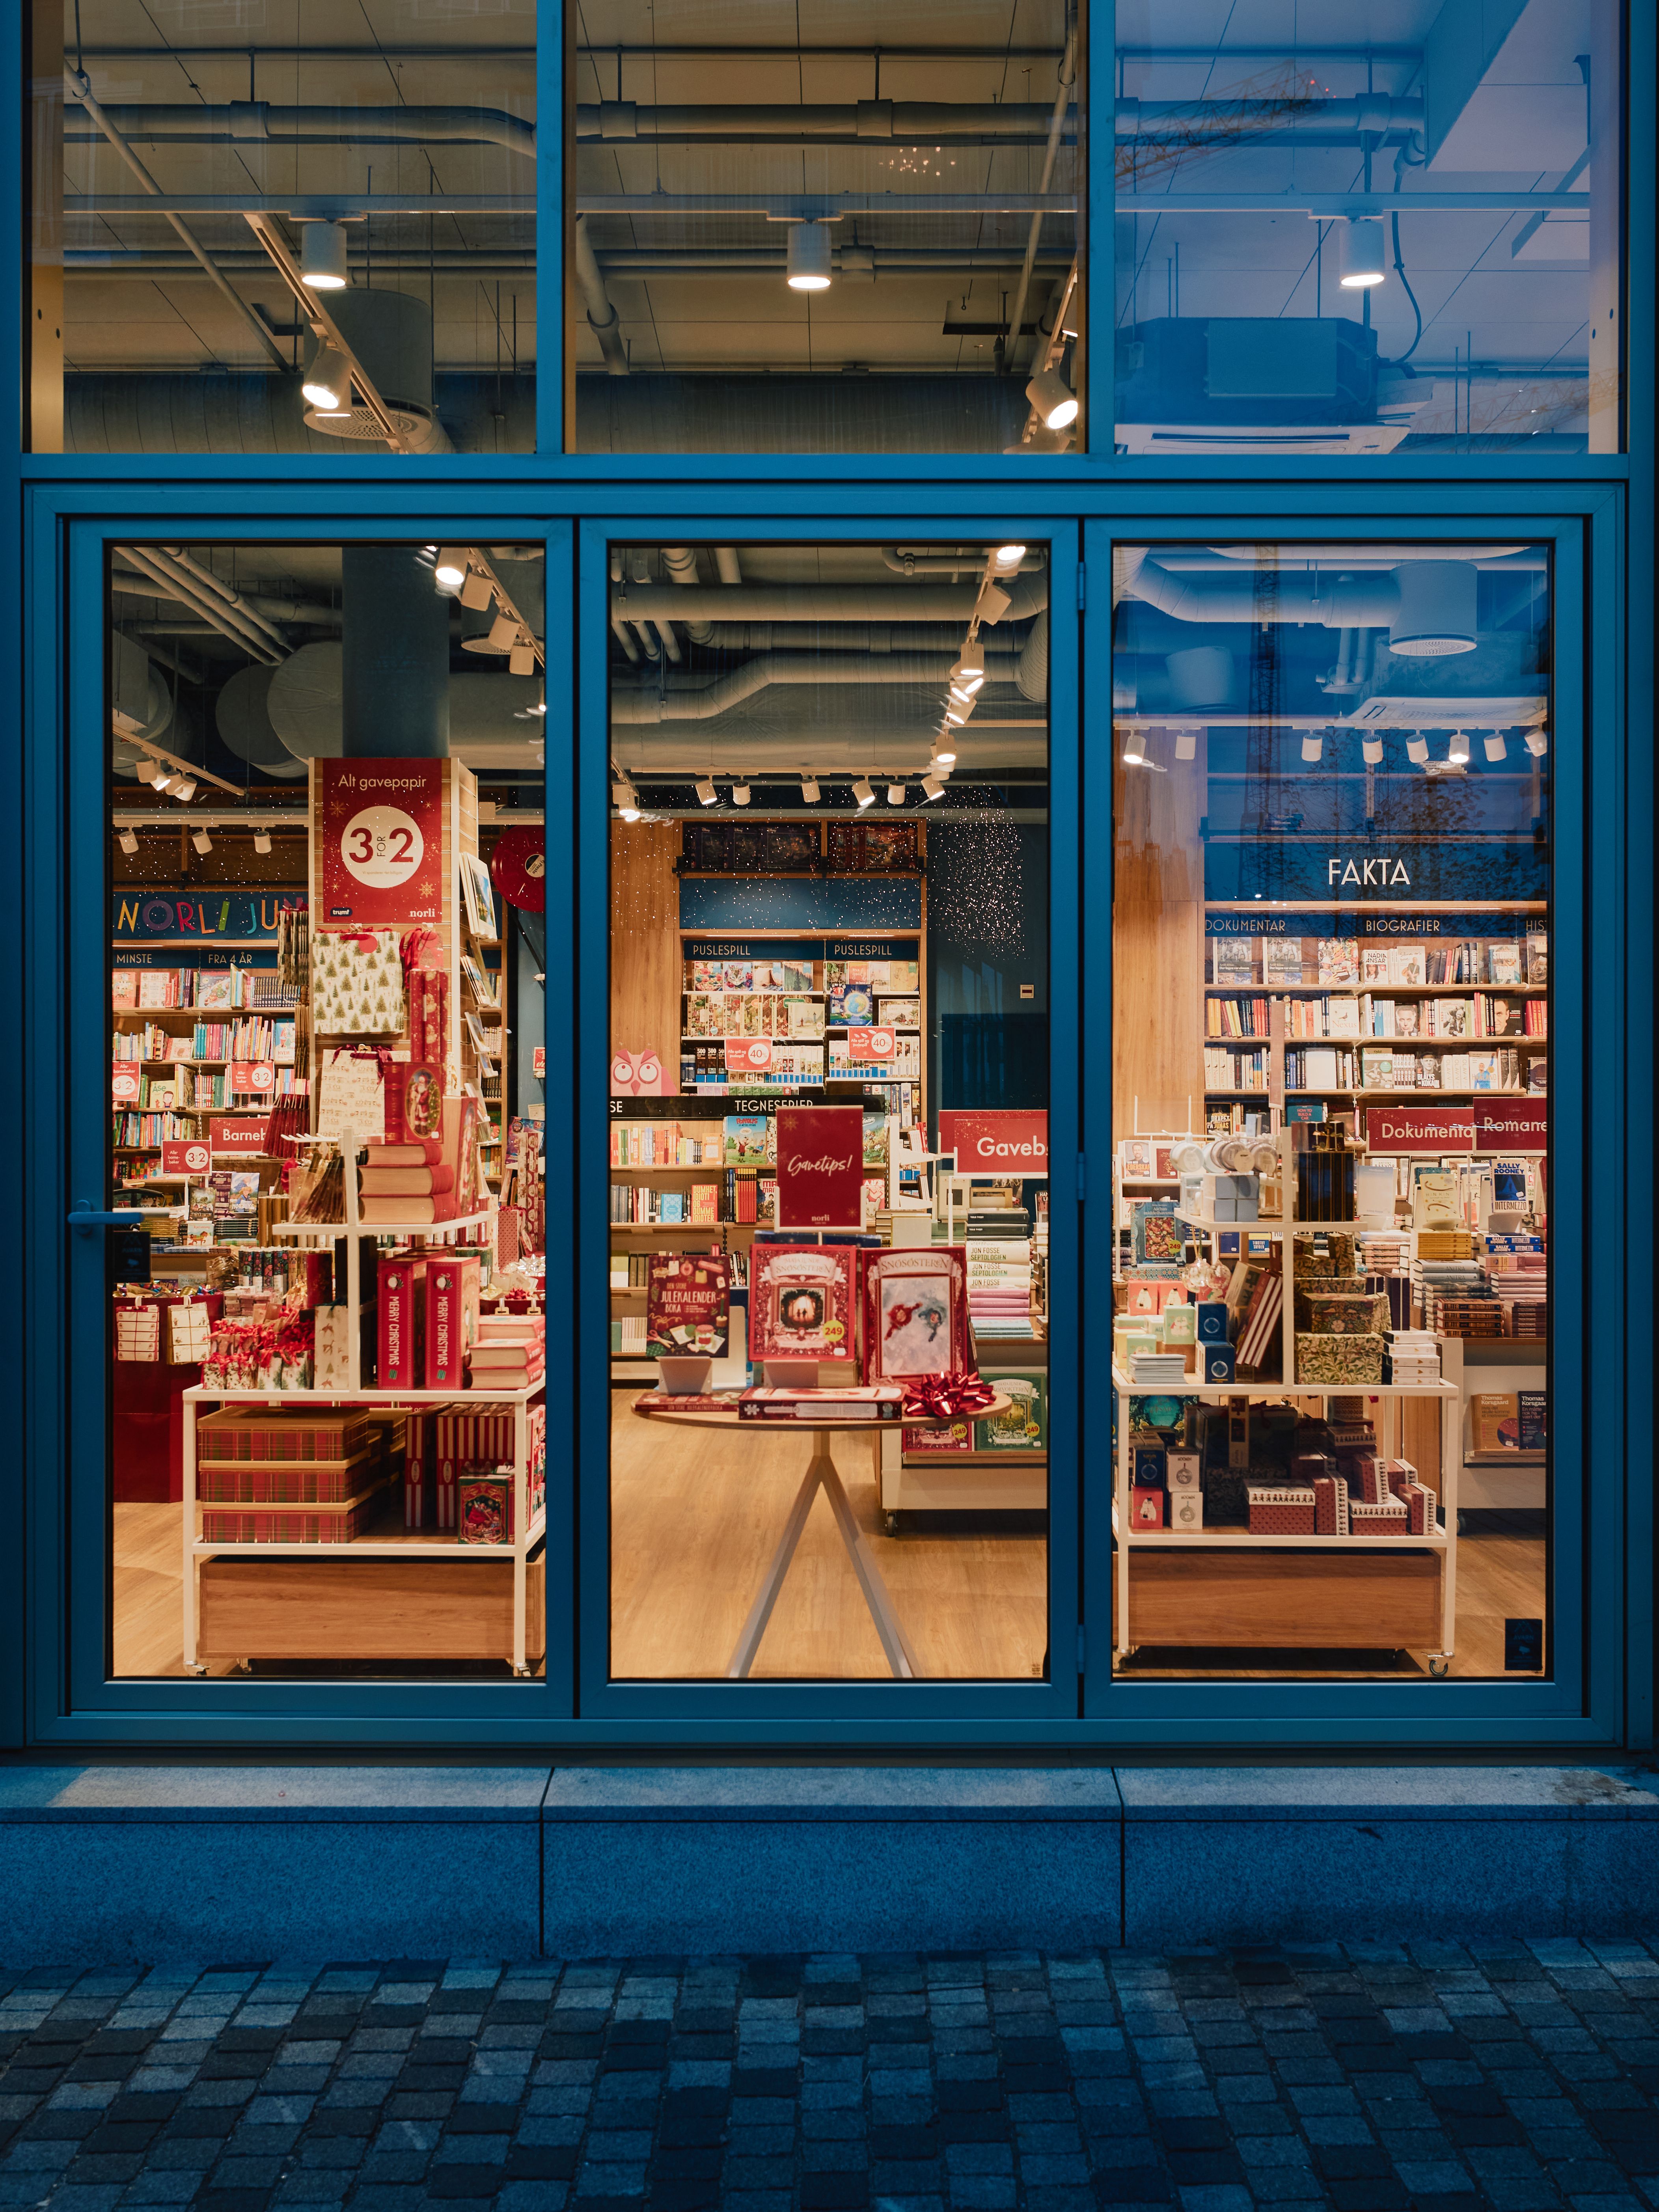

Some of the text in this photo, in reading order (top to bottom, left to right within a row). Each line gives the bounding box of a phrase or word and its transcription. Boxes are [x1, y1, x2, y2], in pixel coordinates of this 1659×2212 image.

[339, 774, 427, 790] Alt gavepapir
[349, 827, 414, 863] 3 FOR 2
[1329, 859, 1411, 885] FAKTA
[117, 899, 230, 935] NORLI
[410, 908, 436, 917] norli
[1205, 919, 1286, 931] DOKUMENTAR
[1366, 920, 1440, 931] BIOGRAFIER
[1526, 920, 1547, 931] HIS
[693, 945, 751, 956] PUSLESPILL
[835, 945, 892, 956] PUSLESPILL
[117, 954, 153, 963] MINSTE
[209, 952, 252, 964] FRA 4 ÅR
[254, 1073, 269, 1081] 3 2
[126, 1081, 132, 1089] 2
[152, 1081, 166, 1092] Åse
[1381, 1122, 1473, 1138] Dokumenta
[977, 1135, 1048, 1156] Gaveb
[188, 1152, 205, 1162] 3 2
[787, 1154, 853, 1177] Gavetips!
[693, 1185, 717, 1194] DUMHET,
[1495, 1201, 1527, 1211] INTERMEZZO
[660, 1290, 721, 1303] JULEKALENDER-
[665, 1304, 681, 1313] BOKA
[389, 1296, 399, 1365] MERRY CHRISTMAS
[437, 1296, 448, 1366] MERRY CHRISTMAS
[825, 1326, 843, 1336] 249
